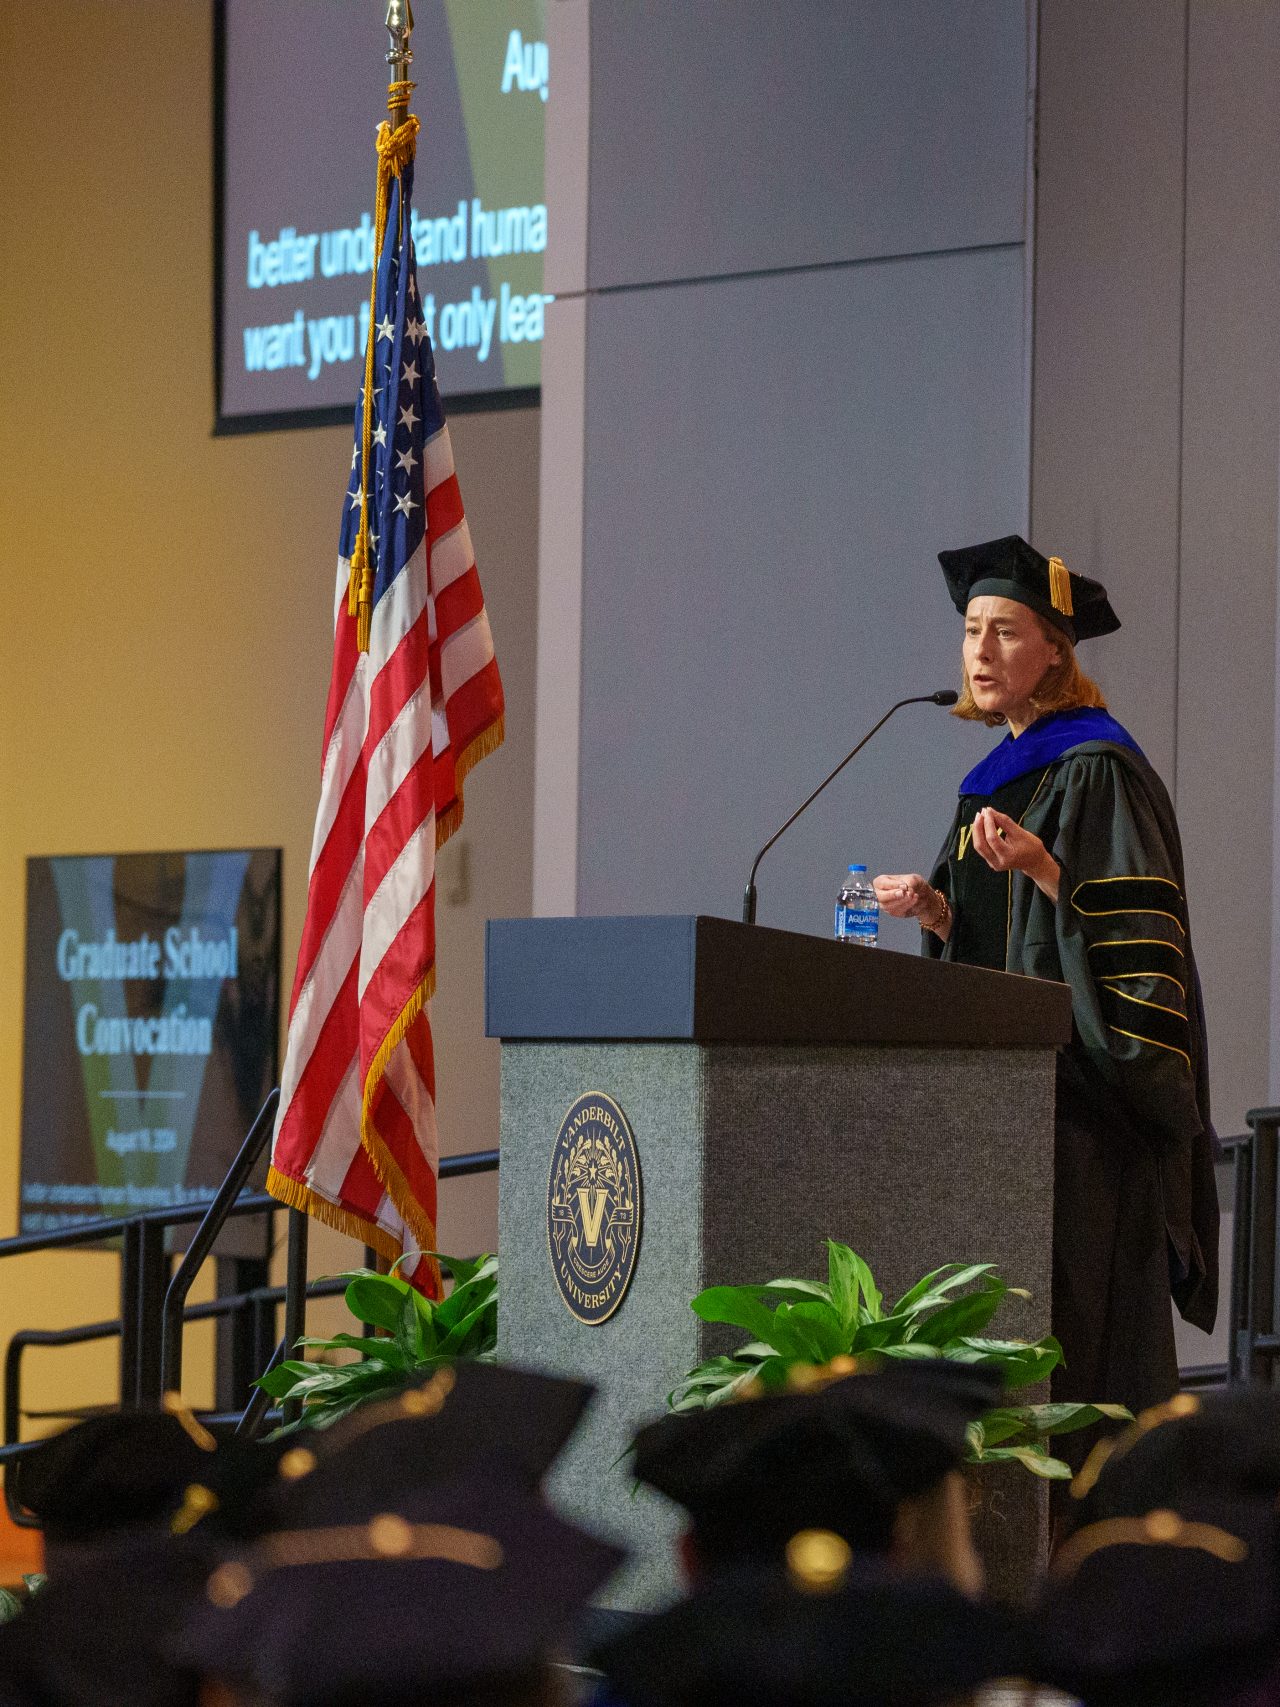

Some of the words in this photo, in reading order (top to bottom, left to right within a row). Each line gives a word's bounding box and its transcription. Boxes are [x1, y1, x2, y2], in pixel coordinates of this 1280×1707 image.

[247, 227, 319, 289] better
[243, 309, 306, 371] want
[306, 314, 355, 380] you
[440, 285, 496, 361] only
[500, 282, 548, 343] lea
[57, 927, 161, 981] Graduate
[163, 926, 239, 979] School
[76, 1003, 213, 1057] Convocation
[562, 1106, 626, 1152] VANDERBILT
[577, 1187, 609, 1247] V
[560, 1261, 622, 1309] UNIVERSITY
